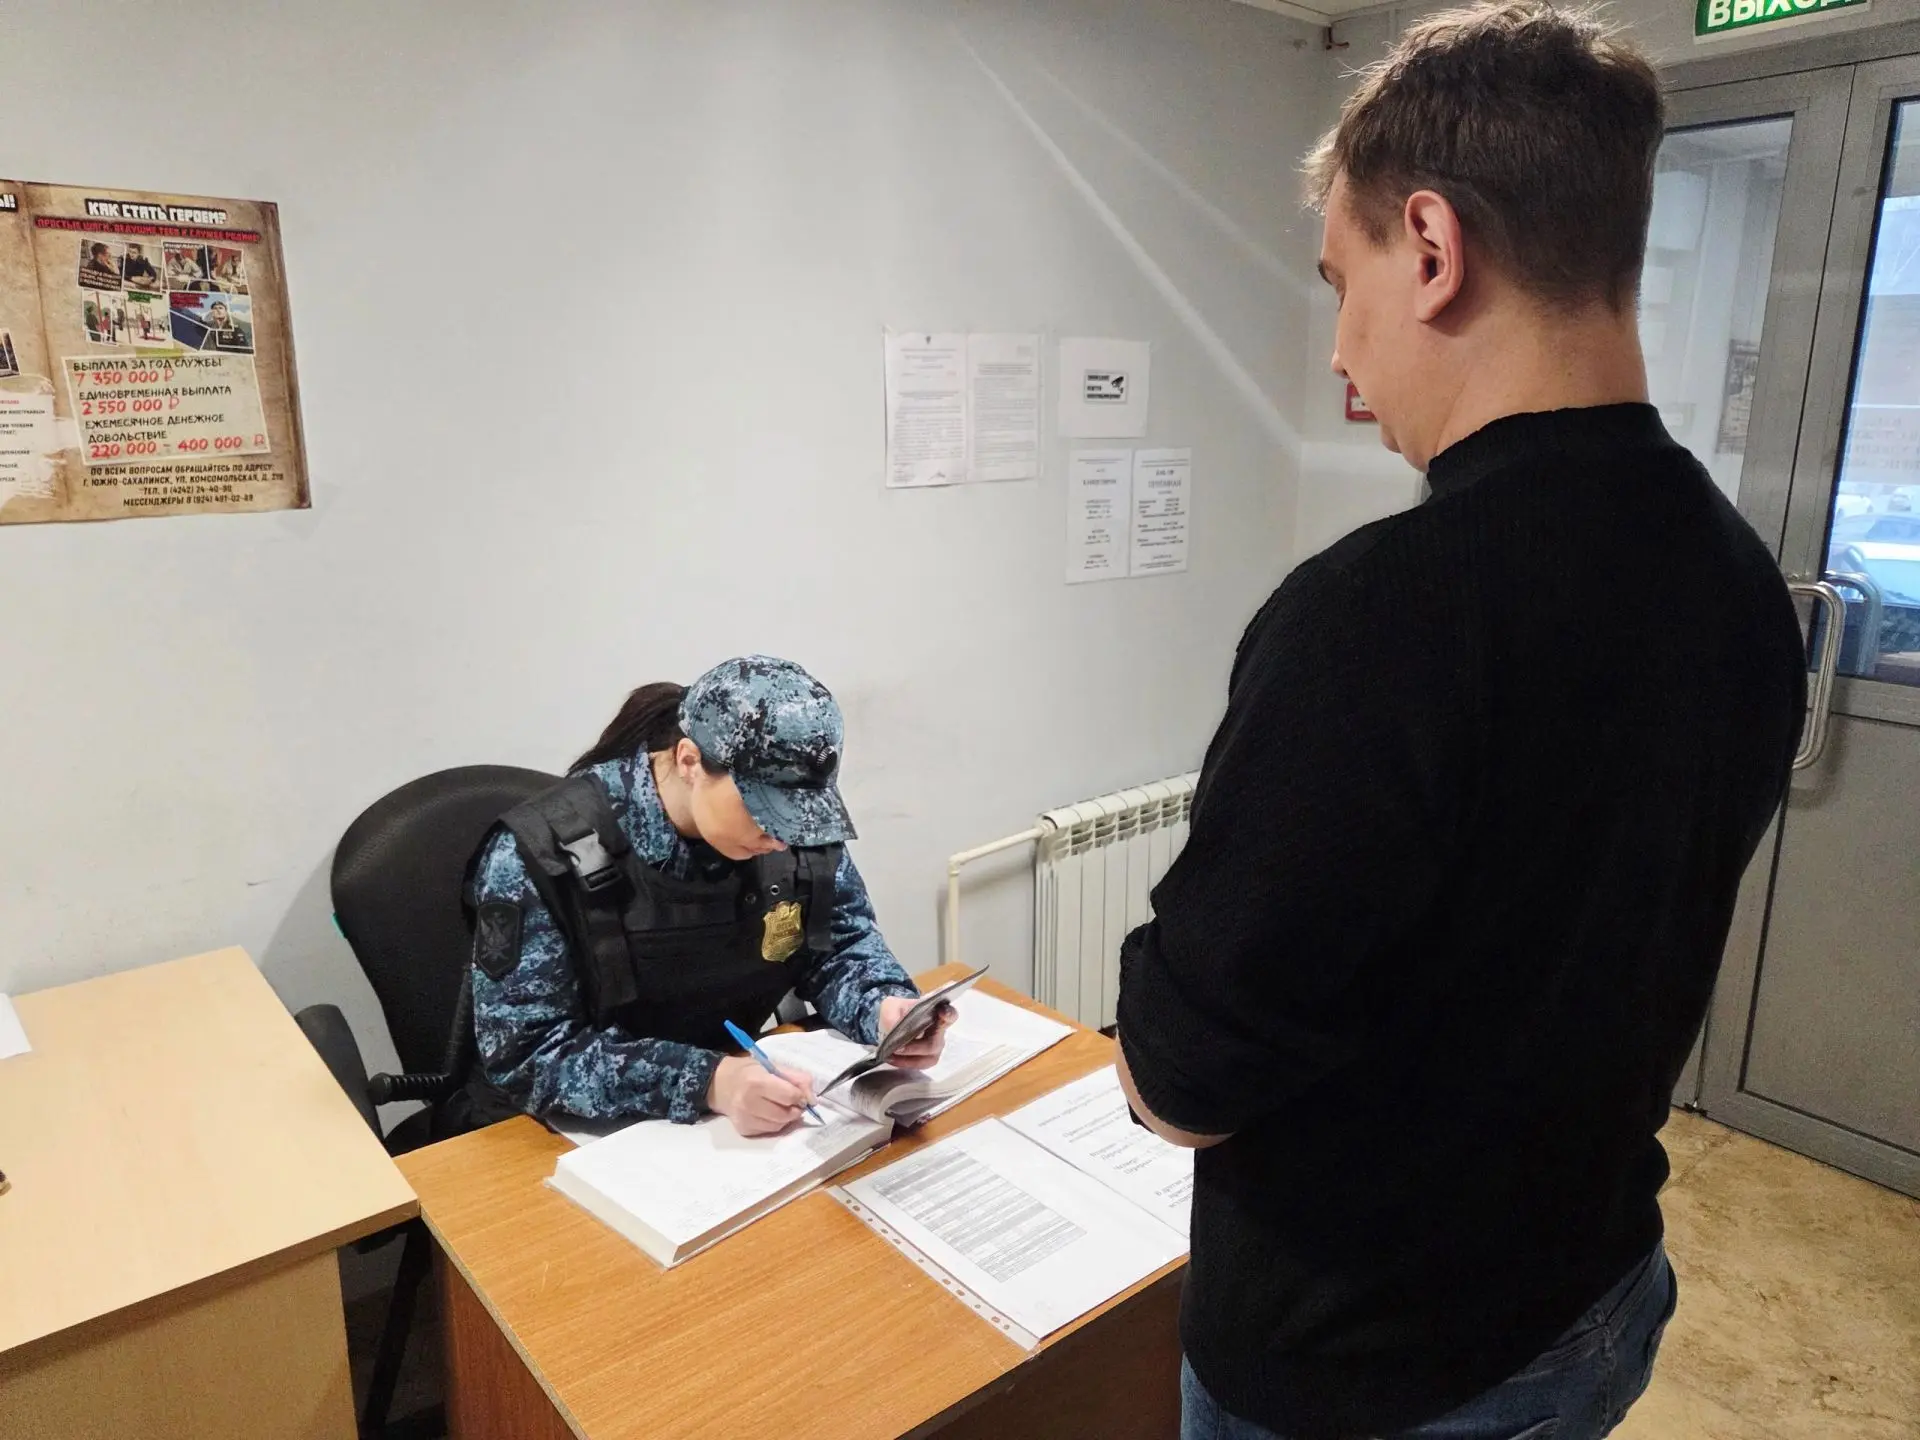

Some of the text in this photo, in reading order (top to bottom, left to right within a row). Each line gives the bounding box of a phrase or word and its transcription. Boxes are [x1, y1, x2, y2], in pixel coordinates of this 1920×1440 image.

[1707, 0, 1851, 28] ВЫХ
[88, 201, 226, 224] КАК СТАТЬ ГЕРОЕМ?
[73, 357, 222, 371] ВЫПЛАТА ЗА ГОД СЛУЖБЫ
[74, 372, 85, 387] 7
[93, 371, 122, 386] 350
[128, 370, 159, 384] 000
[79, 386, 232, 401] ЕДИНОВРЕМЕННАЯ ВЫПЛАТА
[82, 402, 93, 416] 2
[98, 400, 127, 414] 550
[132, 398, 163, 412] 000
[85, 413, 225, 430] ЕЖЕМЕСЯЧНОЕ ДЕНЕЖНОЕ
[88, 430, 168, 444] ДОВОЛЬСТВИЕ
[91, 444, 120, 459] 220
[126, 442, 156, 455] 000
[178, 438, 208, 451] 400
[214, 436, 242, 449] 000
[91, 467, 102, 476] ПО
[105, 466, 126, 475] ВСЕМ
[129, 465, 173, 475] ВОПРОСАМ
[175, 463, 230, 474] ОБРАЩАЙТЕСЬ
[233, 464, 243, 472] ПО
[143, 486, 160, 496] ТЕЛ.
[123, 497, 184, 507] МЕССЕНДЖЕРЫ
